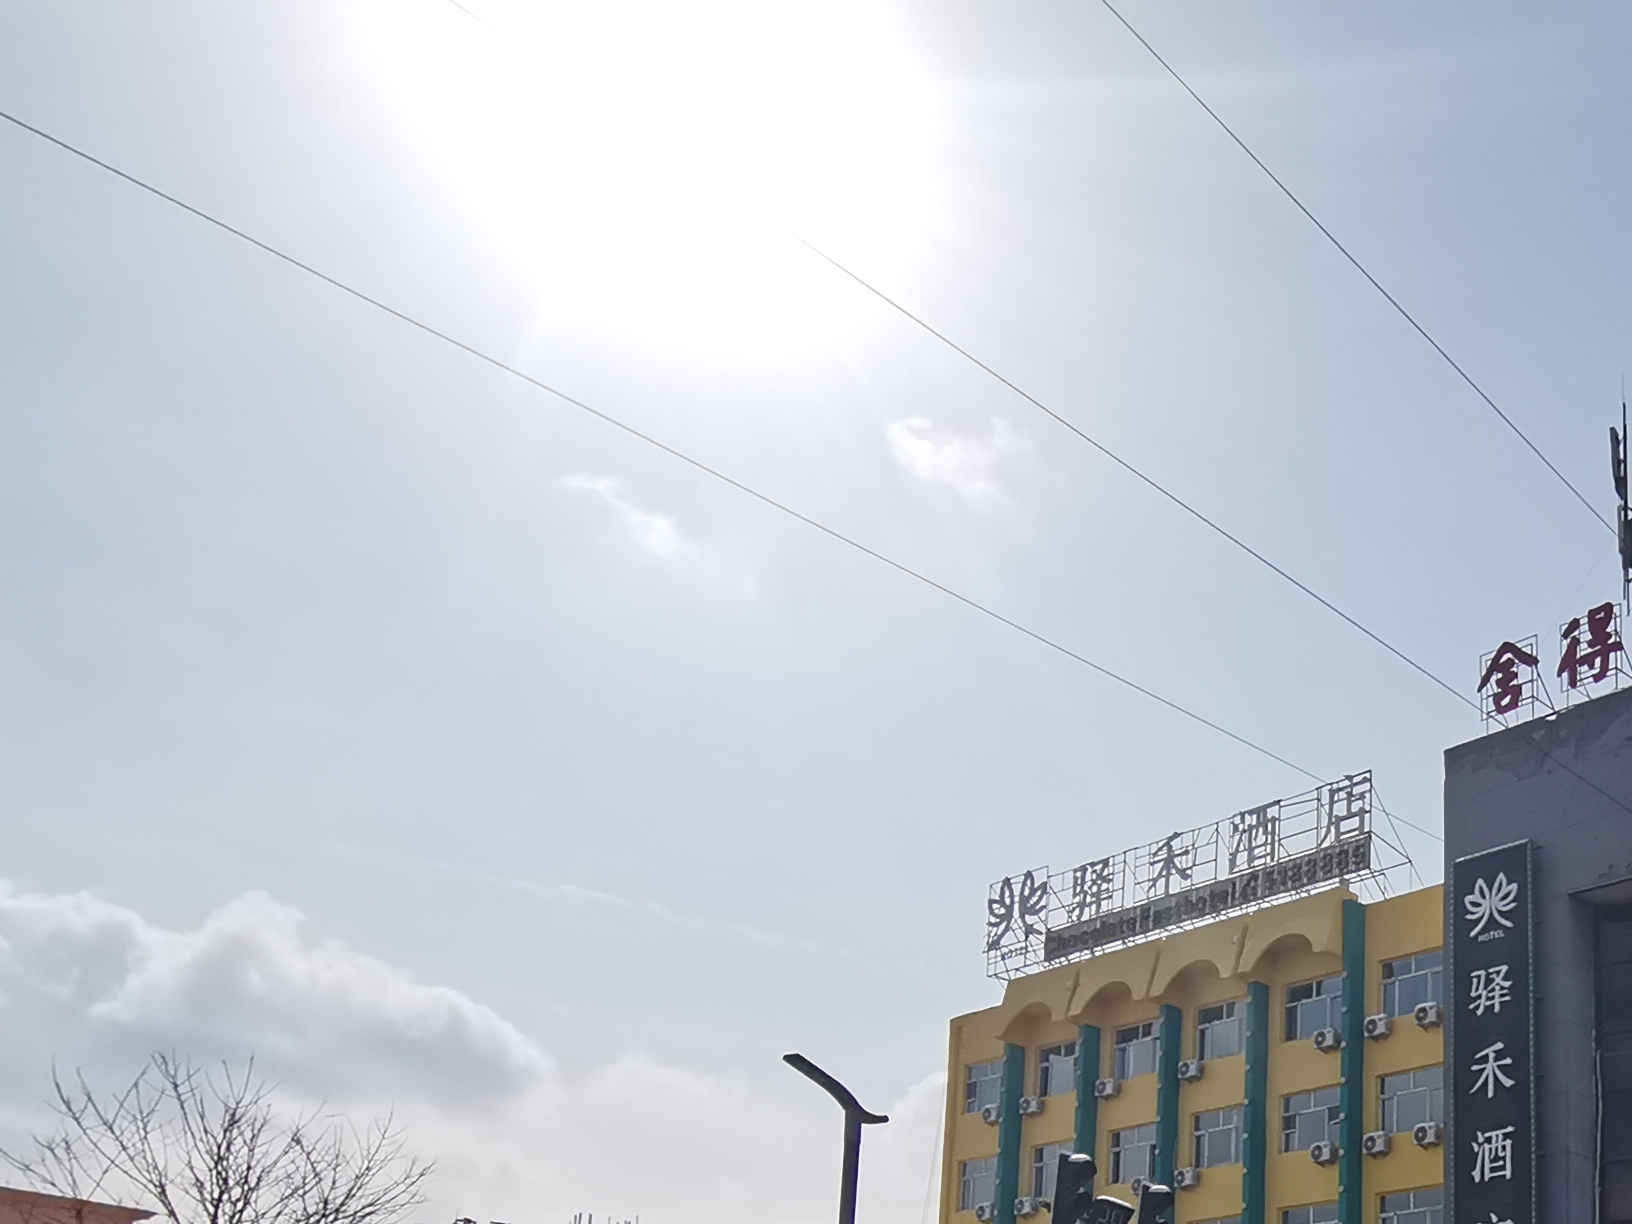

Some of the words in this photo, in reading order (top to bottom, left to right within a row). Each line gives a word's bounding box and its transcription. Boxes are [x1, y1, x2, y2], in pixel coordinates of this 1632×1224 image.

[1071, 774, 1371, 922] 驿禾酒店
[1478, 929, 1505, 943] HOTEL
